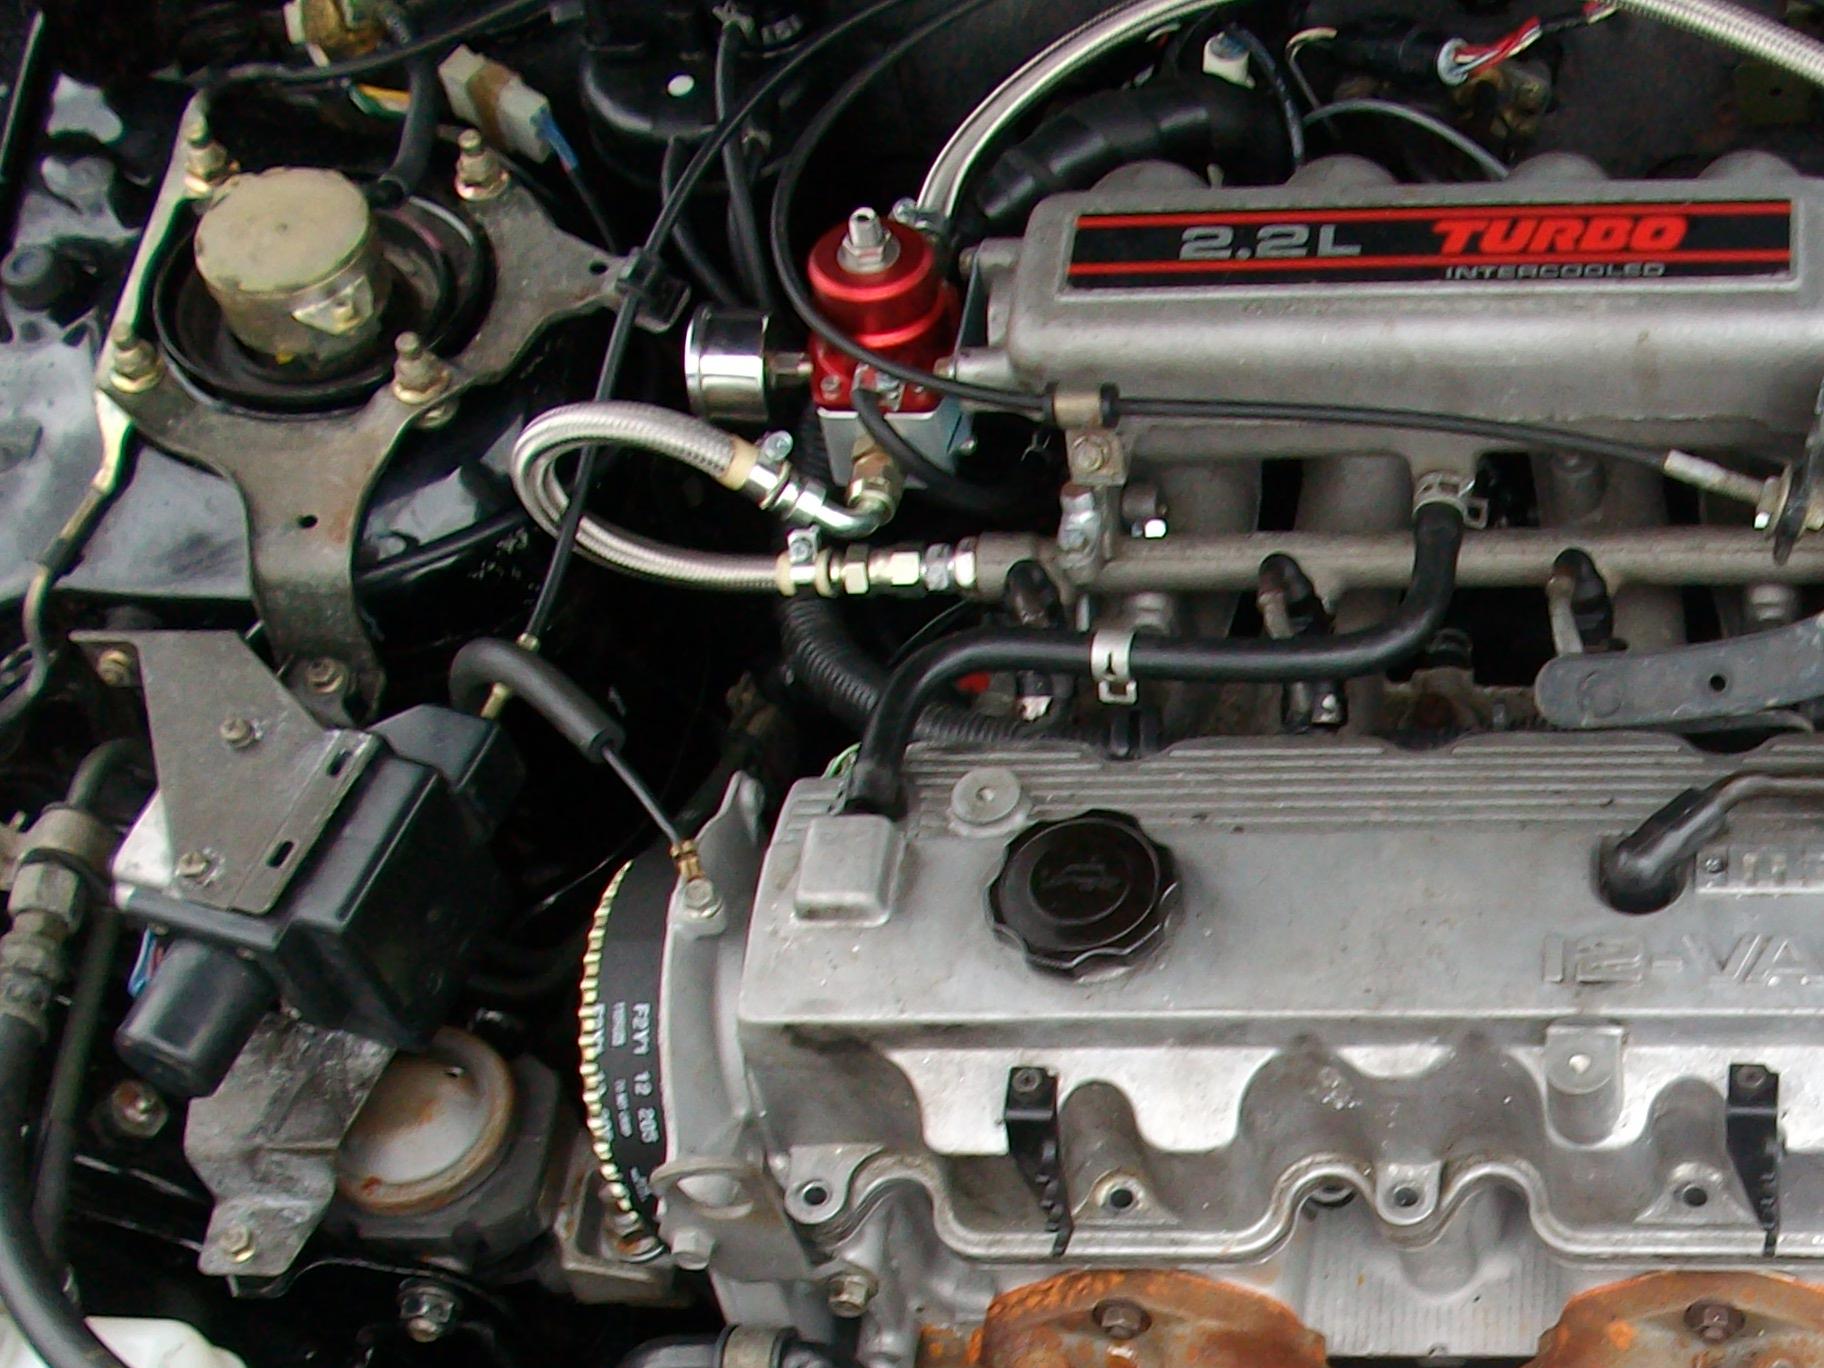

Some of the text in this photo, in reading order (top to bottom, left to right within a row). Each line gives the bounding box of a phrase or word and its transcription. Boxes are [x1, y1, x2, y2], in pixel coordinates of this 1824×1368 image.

[1179, 215, 1688, 261] 2.2L TURBO
[1445, 262, 1665, 280] INTERCOOLED
[633, 1070, 653, 1096] 12
